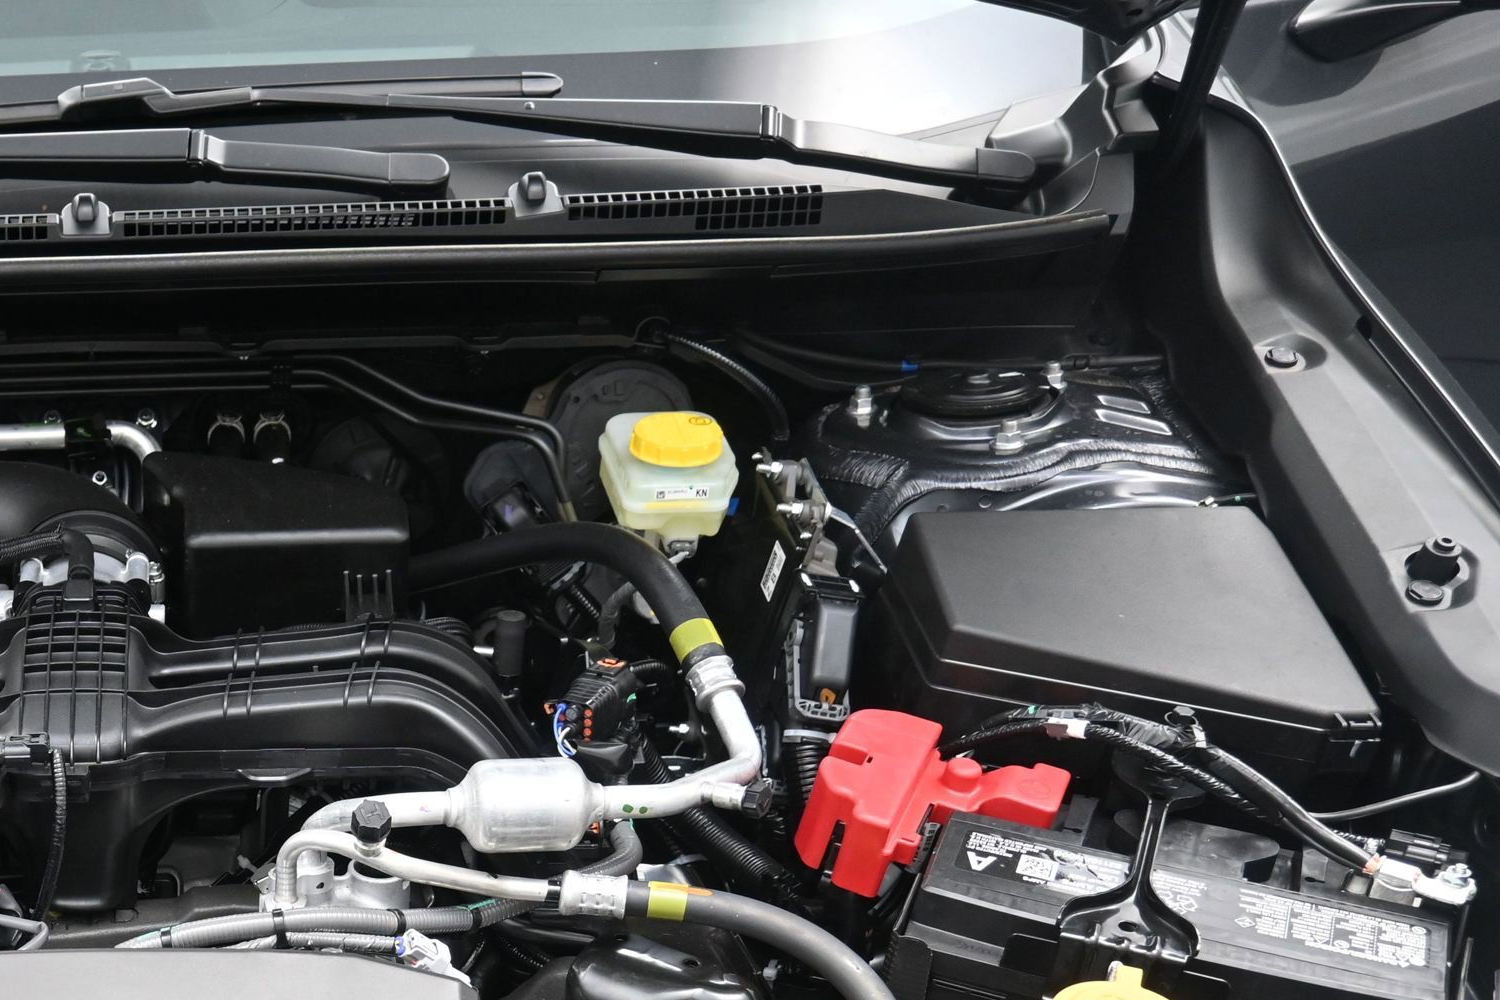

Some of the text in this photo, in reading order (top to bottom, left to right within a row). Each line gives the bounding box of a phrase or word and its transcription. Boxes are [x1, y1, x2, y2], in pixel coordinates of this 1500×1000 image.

[695, 488, 708, 498] KN
[360, 802, 385, 825] H
[966, 850, 997, 872] A
